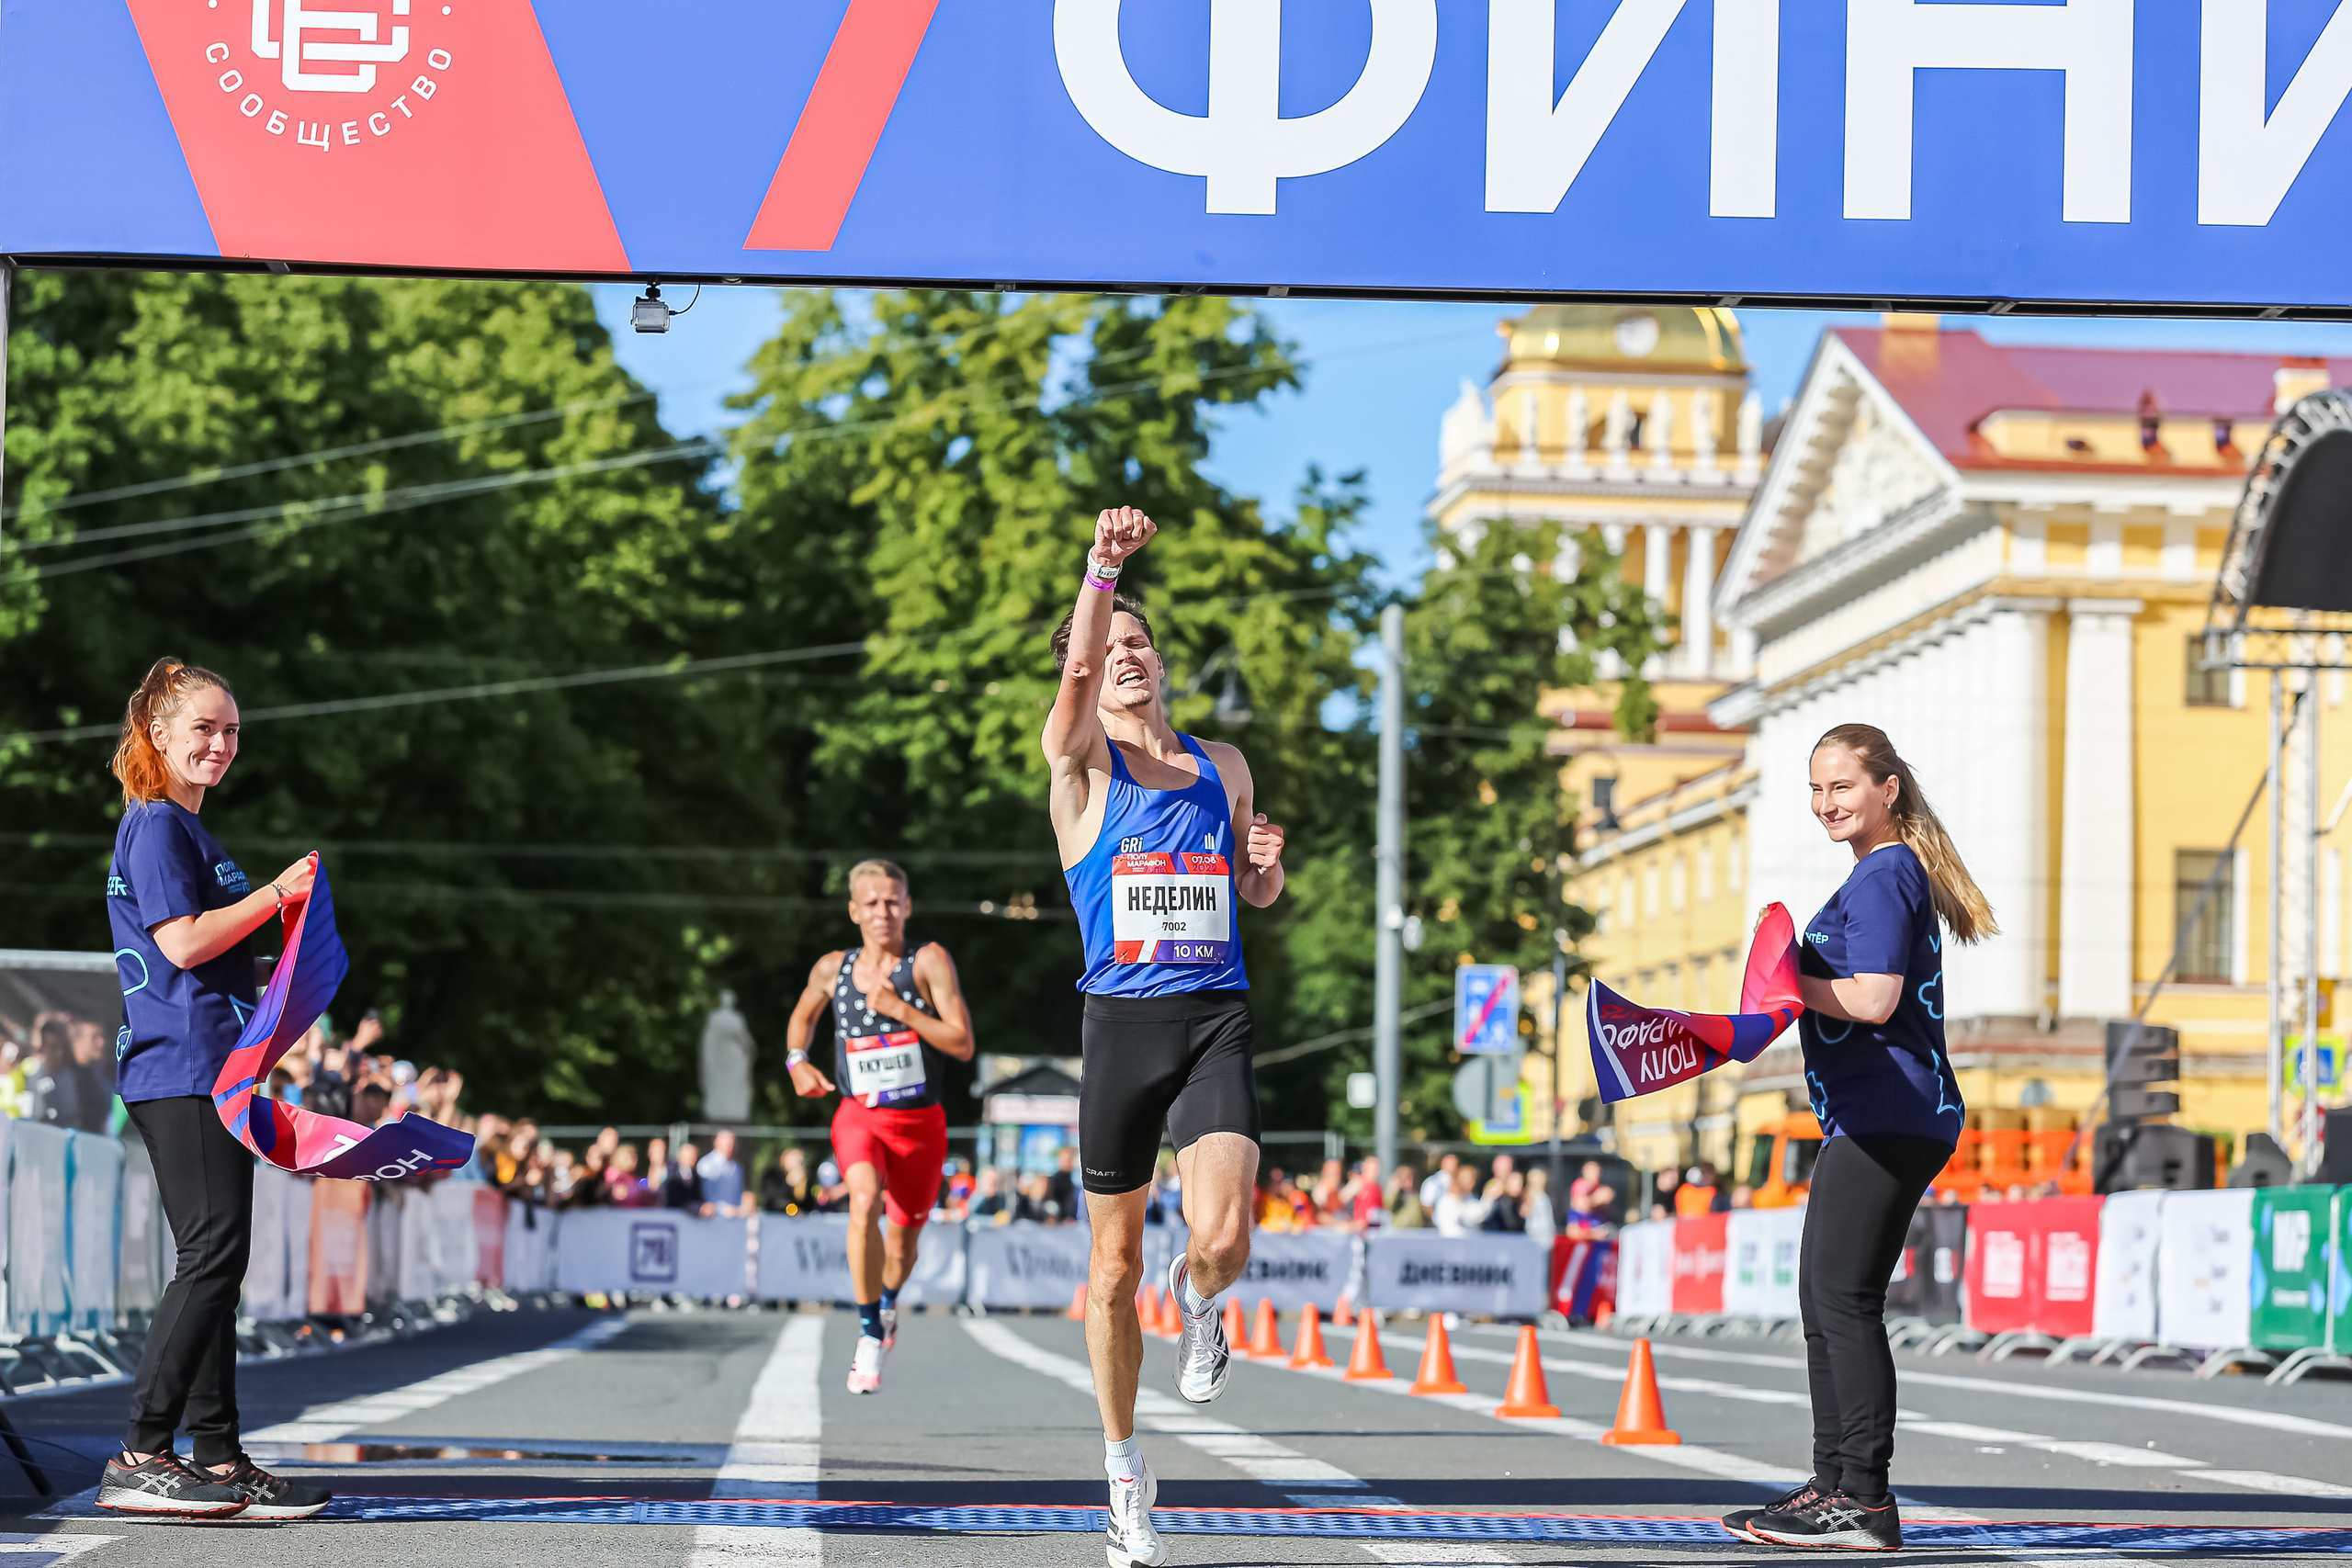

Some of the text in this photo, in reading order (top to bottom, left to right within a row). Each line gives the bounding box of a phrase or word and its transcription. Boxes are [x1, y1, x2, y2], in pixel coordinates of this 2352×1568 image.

[205, 41, 453, 152] СООБЩЕСТВО
[1126, 859, 1167, 868] МАРАФОН
[1191, 855, 1216, 864] 07.08
[1193, 863, 1217, 873] 2022
[1127, 886, 1217, 916] НЕДЕЛИН
[1162, 921, 1187, 931] 7002
[1173, 944, 1192, 959] 10
[1640, 1037, 1698, 1083] ПОЛУ
[1085, 1167, 1117, 1177] CRAFT
